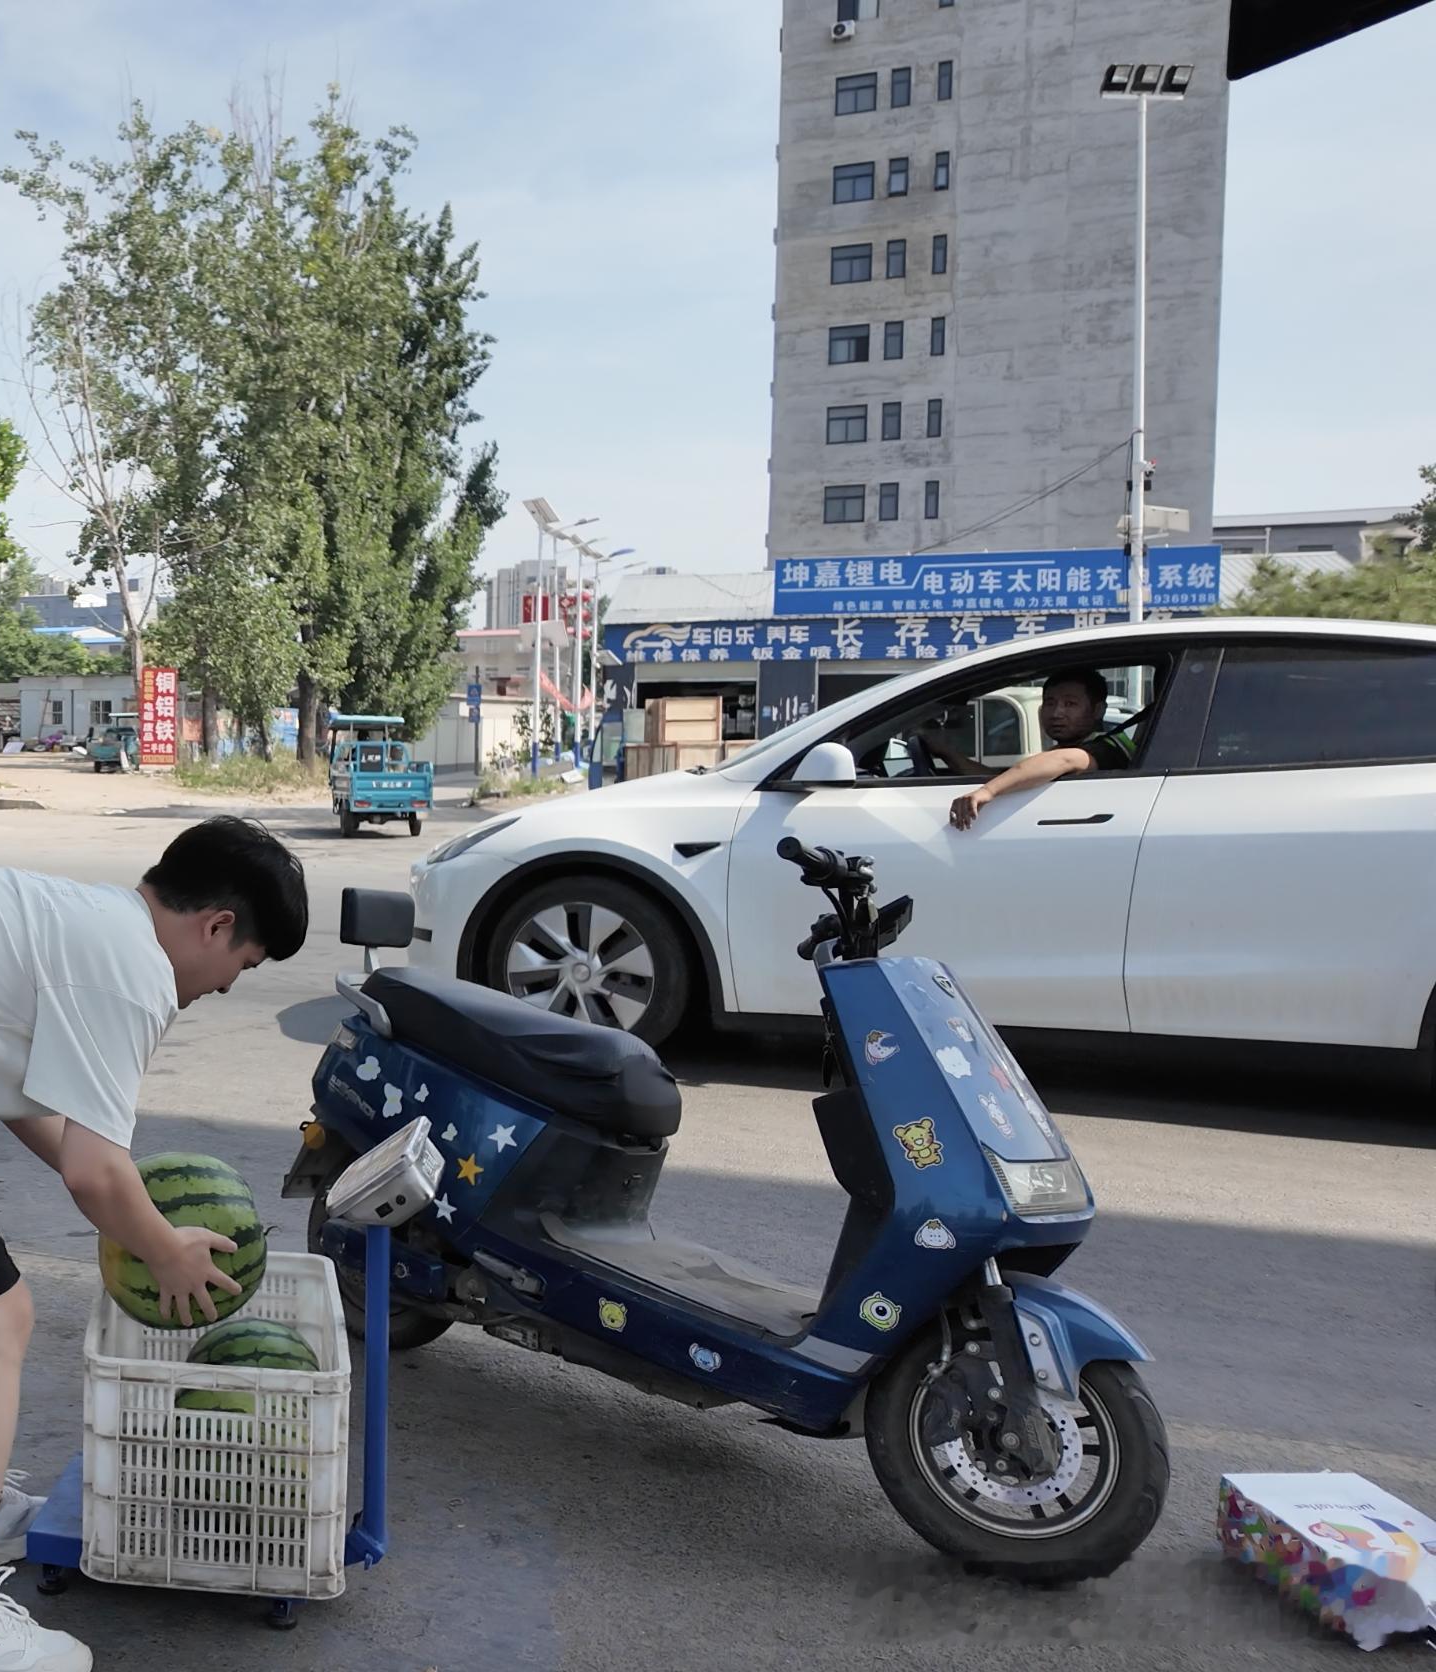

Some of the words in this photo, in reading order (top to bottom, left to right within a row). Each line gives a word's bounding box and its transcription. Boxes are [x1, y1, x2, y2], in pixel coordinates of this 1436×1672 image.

[782, 559, 906, 587] 坤嘉锂电
[1013, 596, 1068, 608] 动力无限
[692, 626, 756, 646] 车伯乐
[626, 647, 730, 662] 维修保养
[751, 646, 862, 661] 钣金喷漆
[885, 645, 988, 659] 车险理
[155, 671, 175, 742] 铜铝铁
